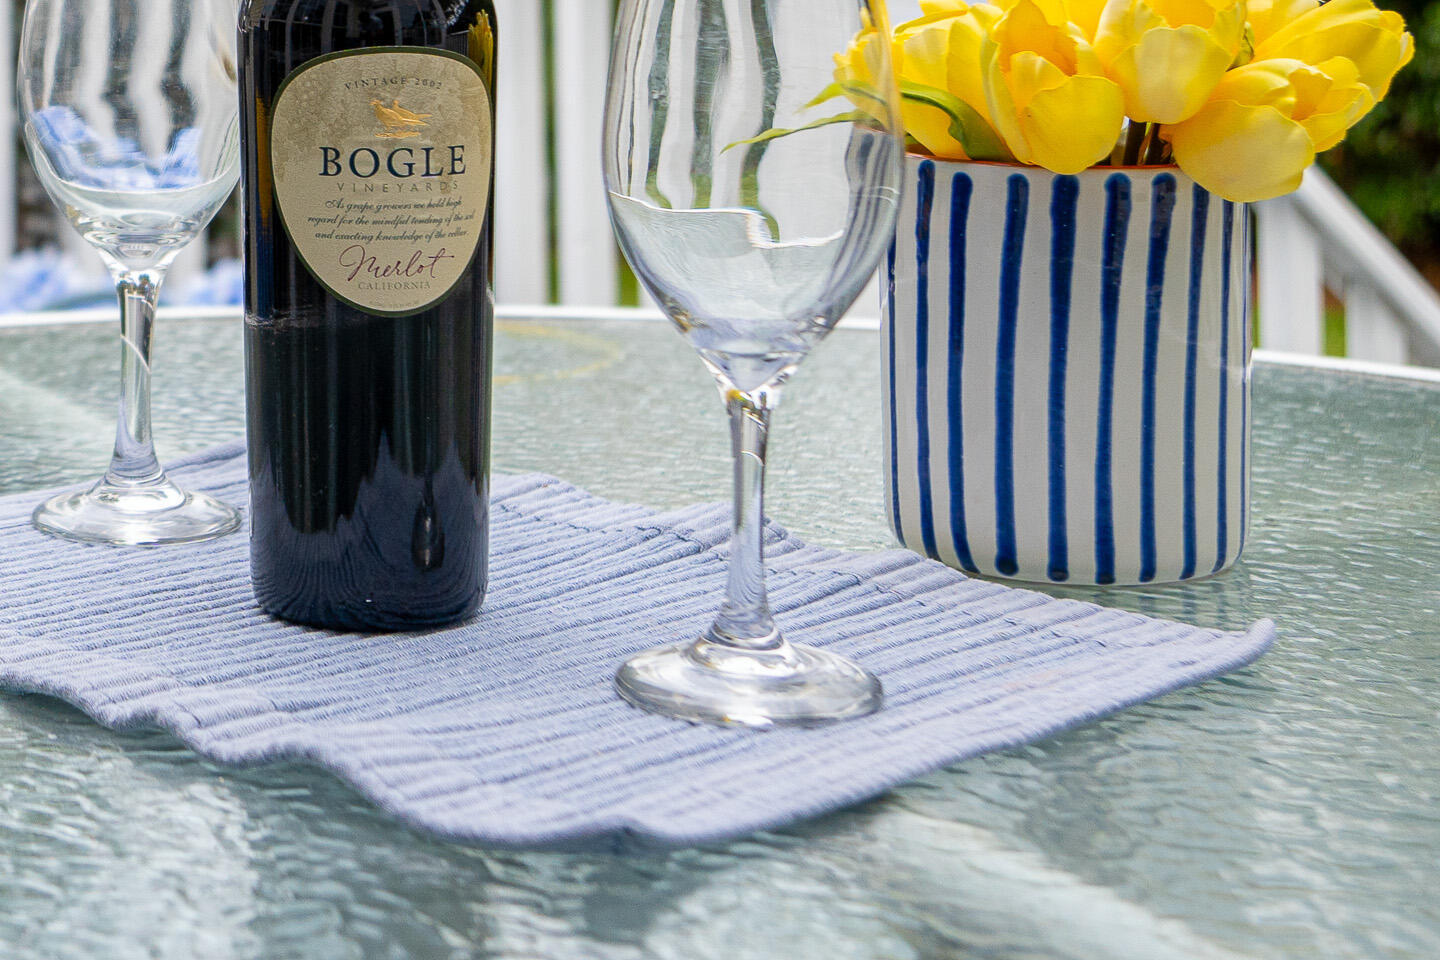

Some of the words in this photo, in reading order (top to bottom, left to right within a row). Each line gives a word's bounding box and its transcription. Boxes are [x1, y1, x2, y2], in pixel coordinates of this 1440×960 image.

[344, 77, 407, 90] VINTAGE
[318, 145, 467, 178] BOGLE
[336, 180, 459, 193] VINEYARDS
[345, 202, 374, 214] grape
[307, 214, 340, 227] regard
[355, 215, 369, 225] the
[315, 229, 335, 239] and
[339, 244, 455, 282] Merlot
[357, 280, 432, 291] CALIFORNIA
